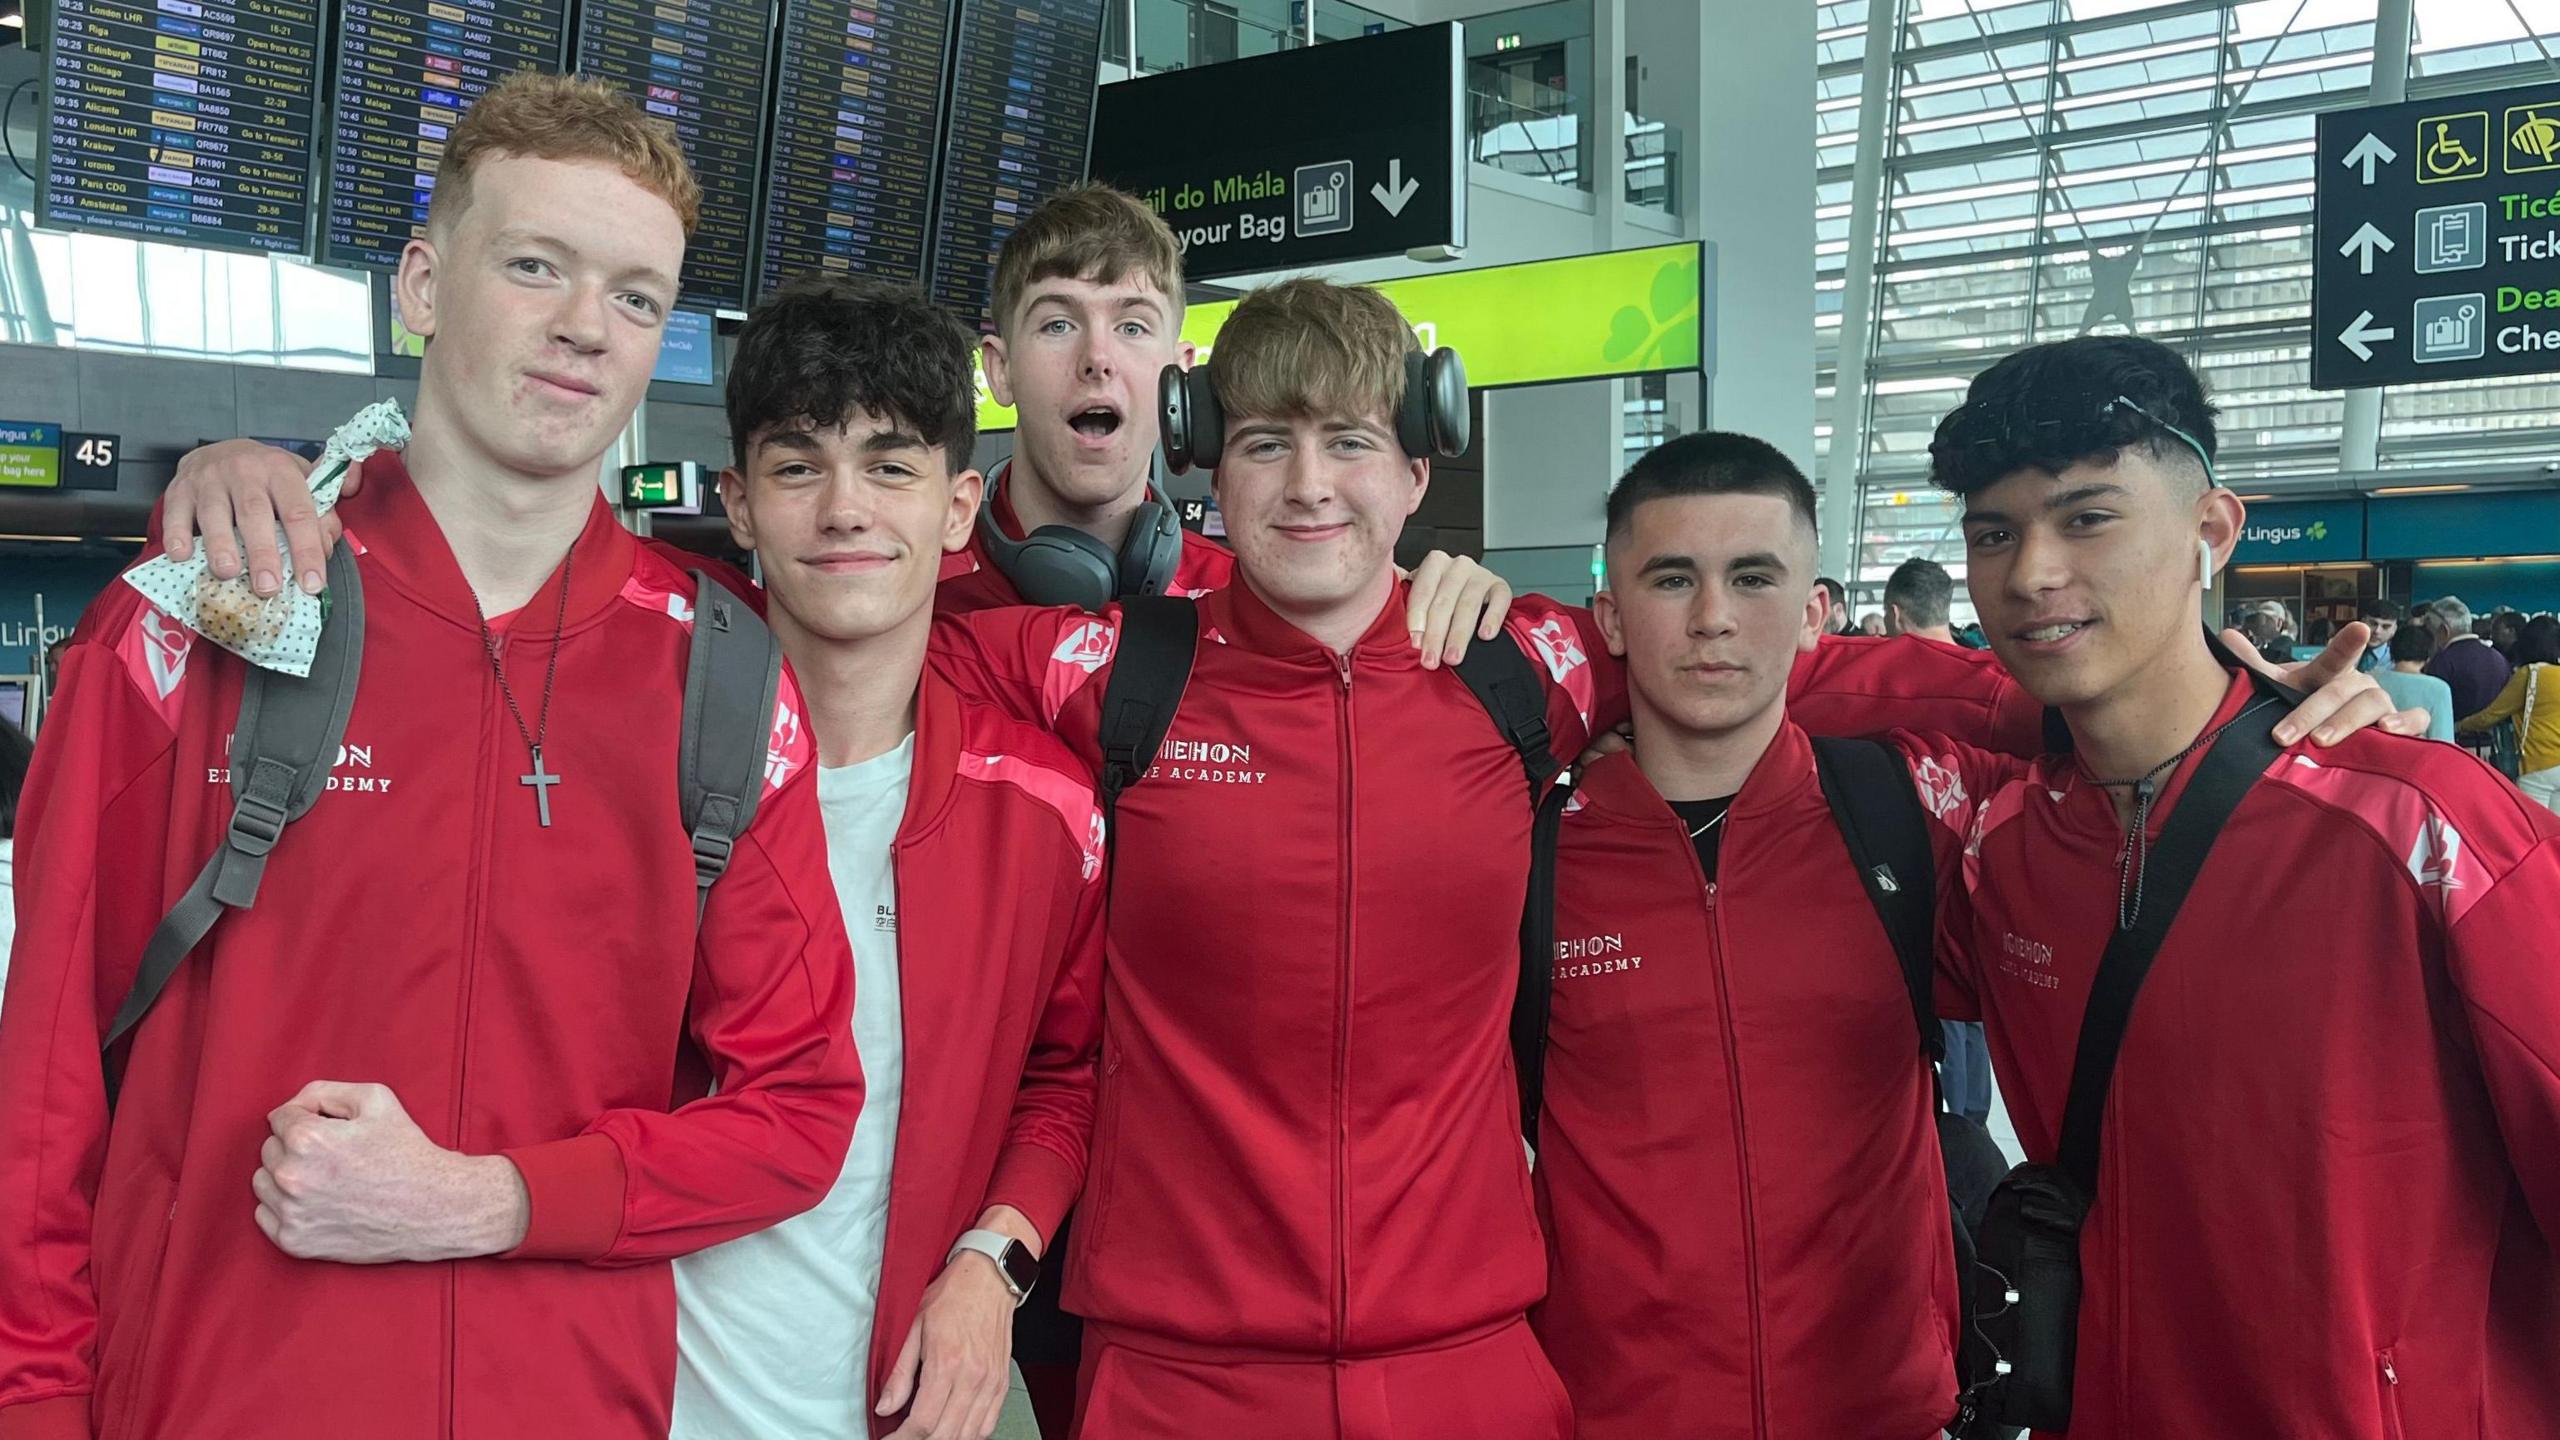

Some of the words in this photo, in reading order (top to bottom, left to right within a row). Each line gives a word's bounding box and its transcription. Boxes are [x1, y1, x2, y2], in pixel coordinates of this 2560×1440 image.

[90, 5, 121, 19] London
[58, 18, 82, 31] 09:25
[88, 24, 108, 36] Riga
[56, 38, 82, 50] 09:25
[247, 38, 268, 49] Open
[270, 42, 287, 53] from
[88, 44, 132, 60] Edinburgh
[56, 57, 81, 70] 09:30
[87, 63, 122, 78] Chicago
[55, 77, 80, 89] 09:30
[86, 82, 126, 98] Liverpool
[54, 96, 79, 108] 09:35
[85, 101, 120, 116] Alicante
[54, 116, 78, 128] 09:45
[84, 120, 116, 134] London
[52, 134, 78, 146] 09:45
[83, 140, 115, 153] Krakow
[50, 174, 76, 186] 09:50
[81, 178, 104, 190] Paris
[1174, 184, 1205, 210] do
[1213, 170, 1286, 206] Mhála
[80, 198, 128, 213] Amsterdam
[1178, 223, 1232, 255] your
[1239, 214, 1286, 242] Bag
[2498, 230, 2560, 262] Tick
[2496, 324, 2560, 354] Che
[10, 453, 32, 464] your
[76, 440, 113, 468] 45
[4, 465, 22, 478] bag
[24, 466, 46, 477] here
[1185, 503, 1202, 521] 54
[2248, 526, 2301, 545] Lingus
[1170, 767, 1266, 784] ACADEMY
[326, 777, 392, 793] DEMY
[1560, 956, 1642, 979] ACADEMY
